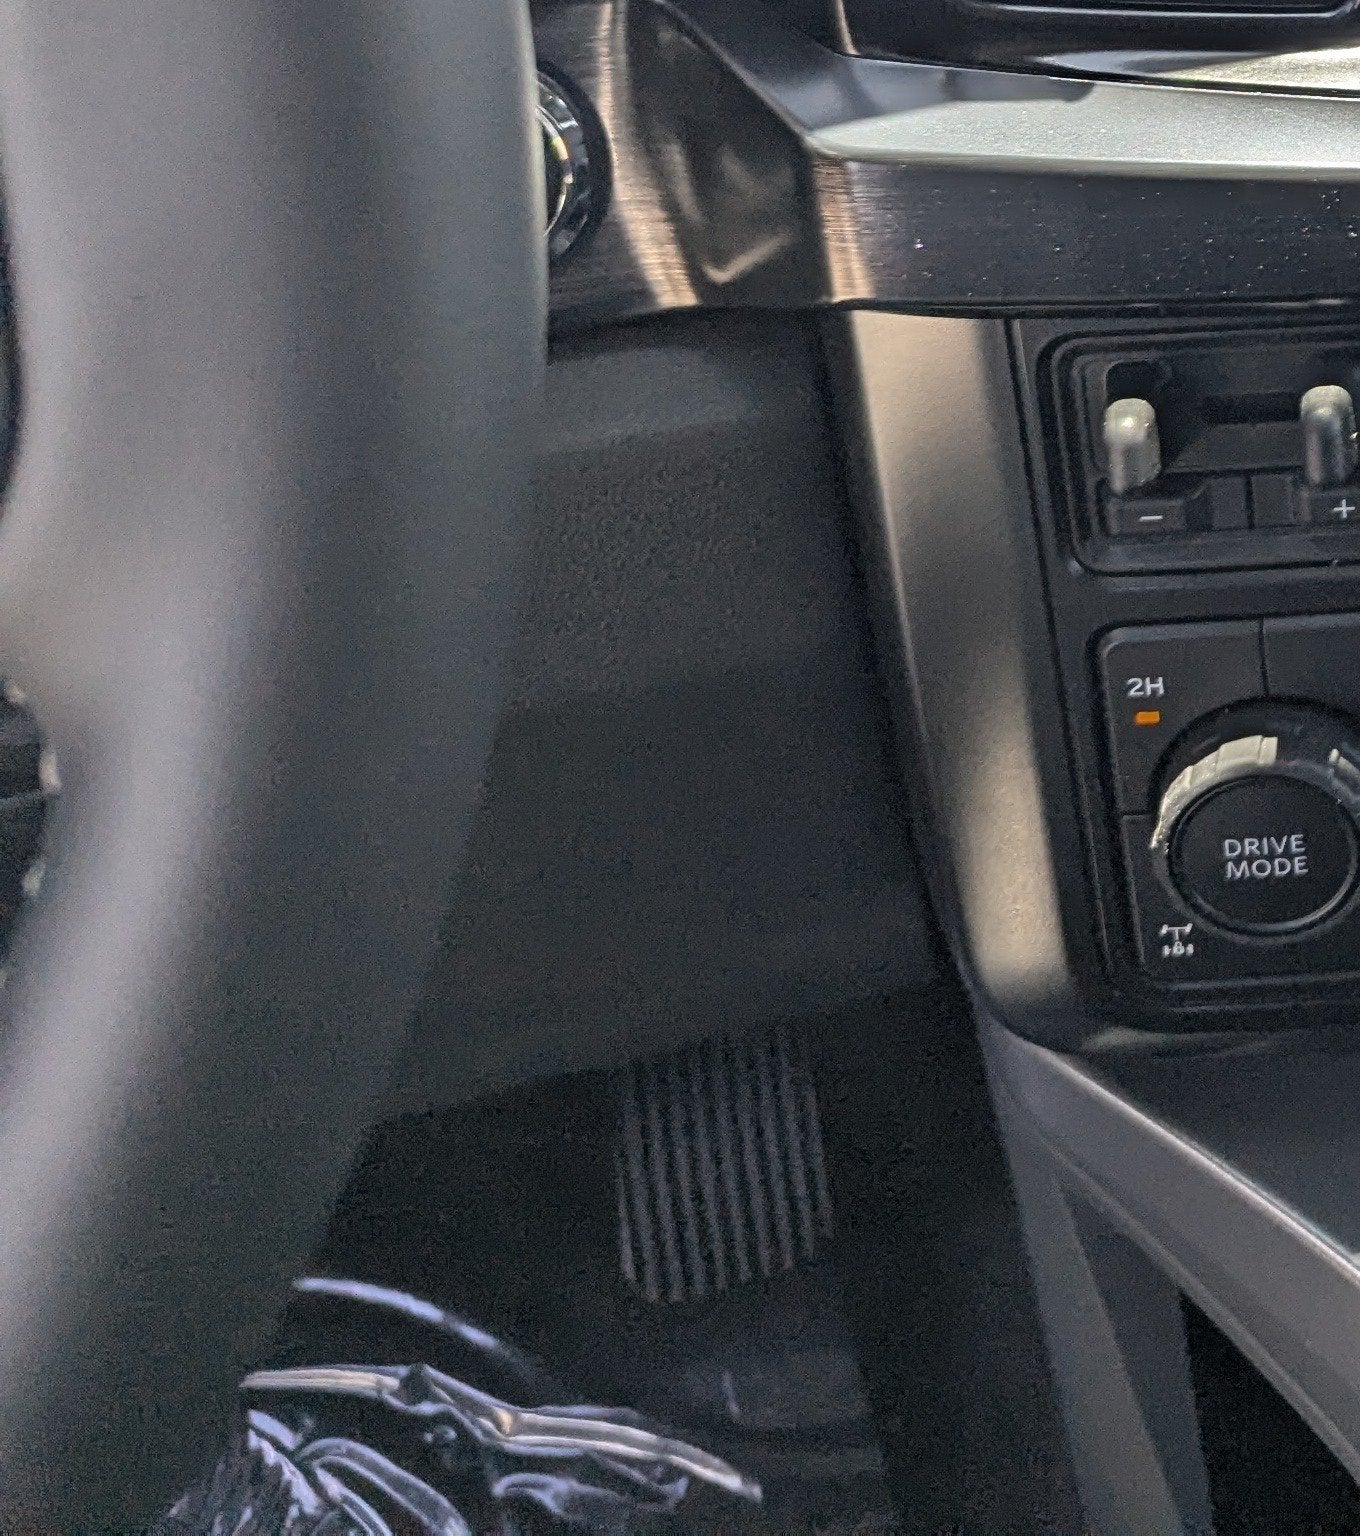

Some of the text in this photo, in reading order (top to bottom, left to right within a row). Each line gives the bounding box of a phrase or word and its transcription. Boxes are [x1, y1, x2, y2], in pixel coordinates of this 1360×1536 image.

[1126, 676, 1164, 697] 2H
[1223, 835, 1306, 858] DRIVE
[1224, 855, 1309, 879] MODE
